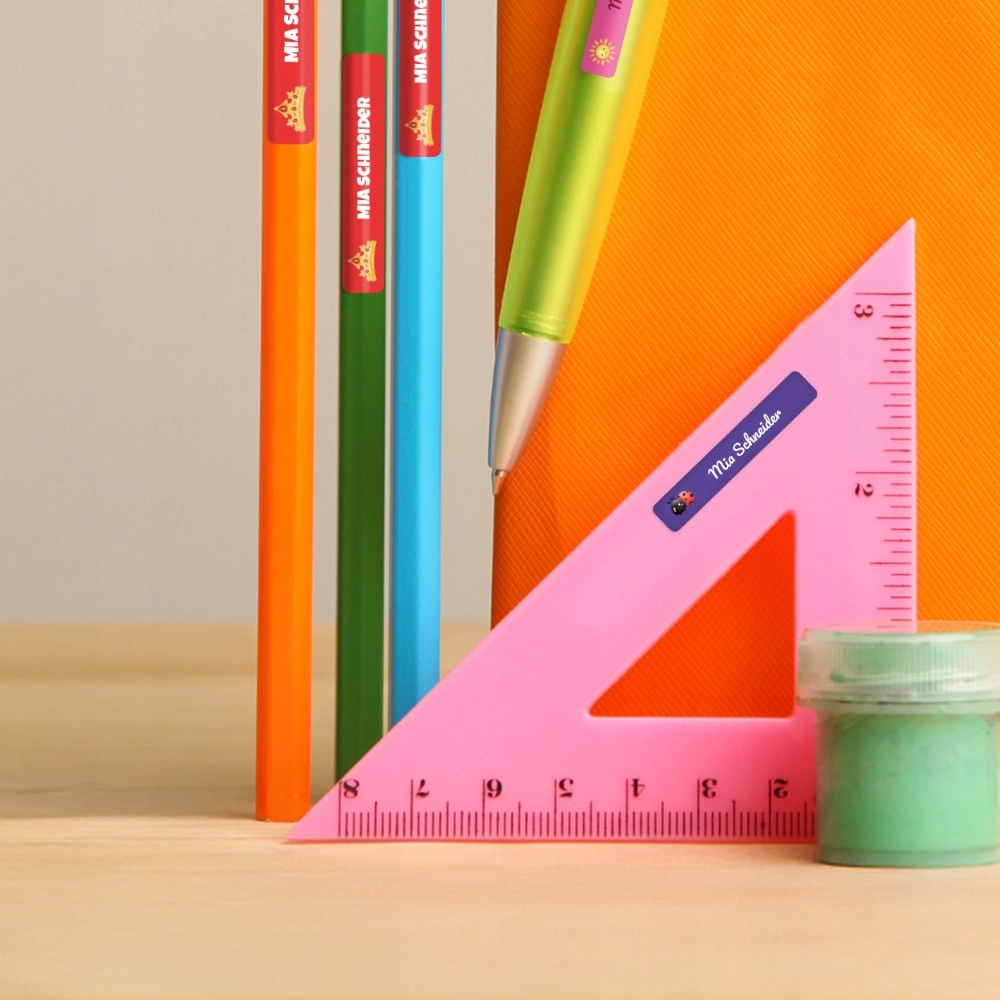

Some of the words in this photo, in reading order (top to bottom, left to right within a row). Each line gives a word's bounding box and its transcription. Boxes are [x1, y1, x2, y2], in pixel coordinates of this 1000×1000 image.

[283, 25, 300, 63] MIA
[413, 50, 429, 84] MIA
[356, 186, 371, 220] MIA
[854, 303, 874, 319] 3
[707, 455, 736, 480] Mia
[732, 410, 782, 457] Schneider
[854, 483, 874, 498] 2
[342, 778, 360, 799] 8
[415, 778, 430, 798] 7
[558, 778, 575, 798] 5
[631, 778, 645, 798] 4
[701, 778, 718, 799] 3
[773, 778, 789, 799] 2
